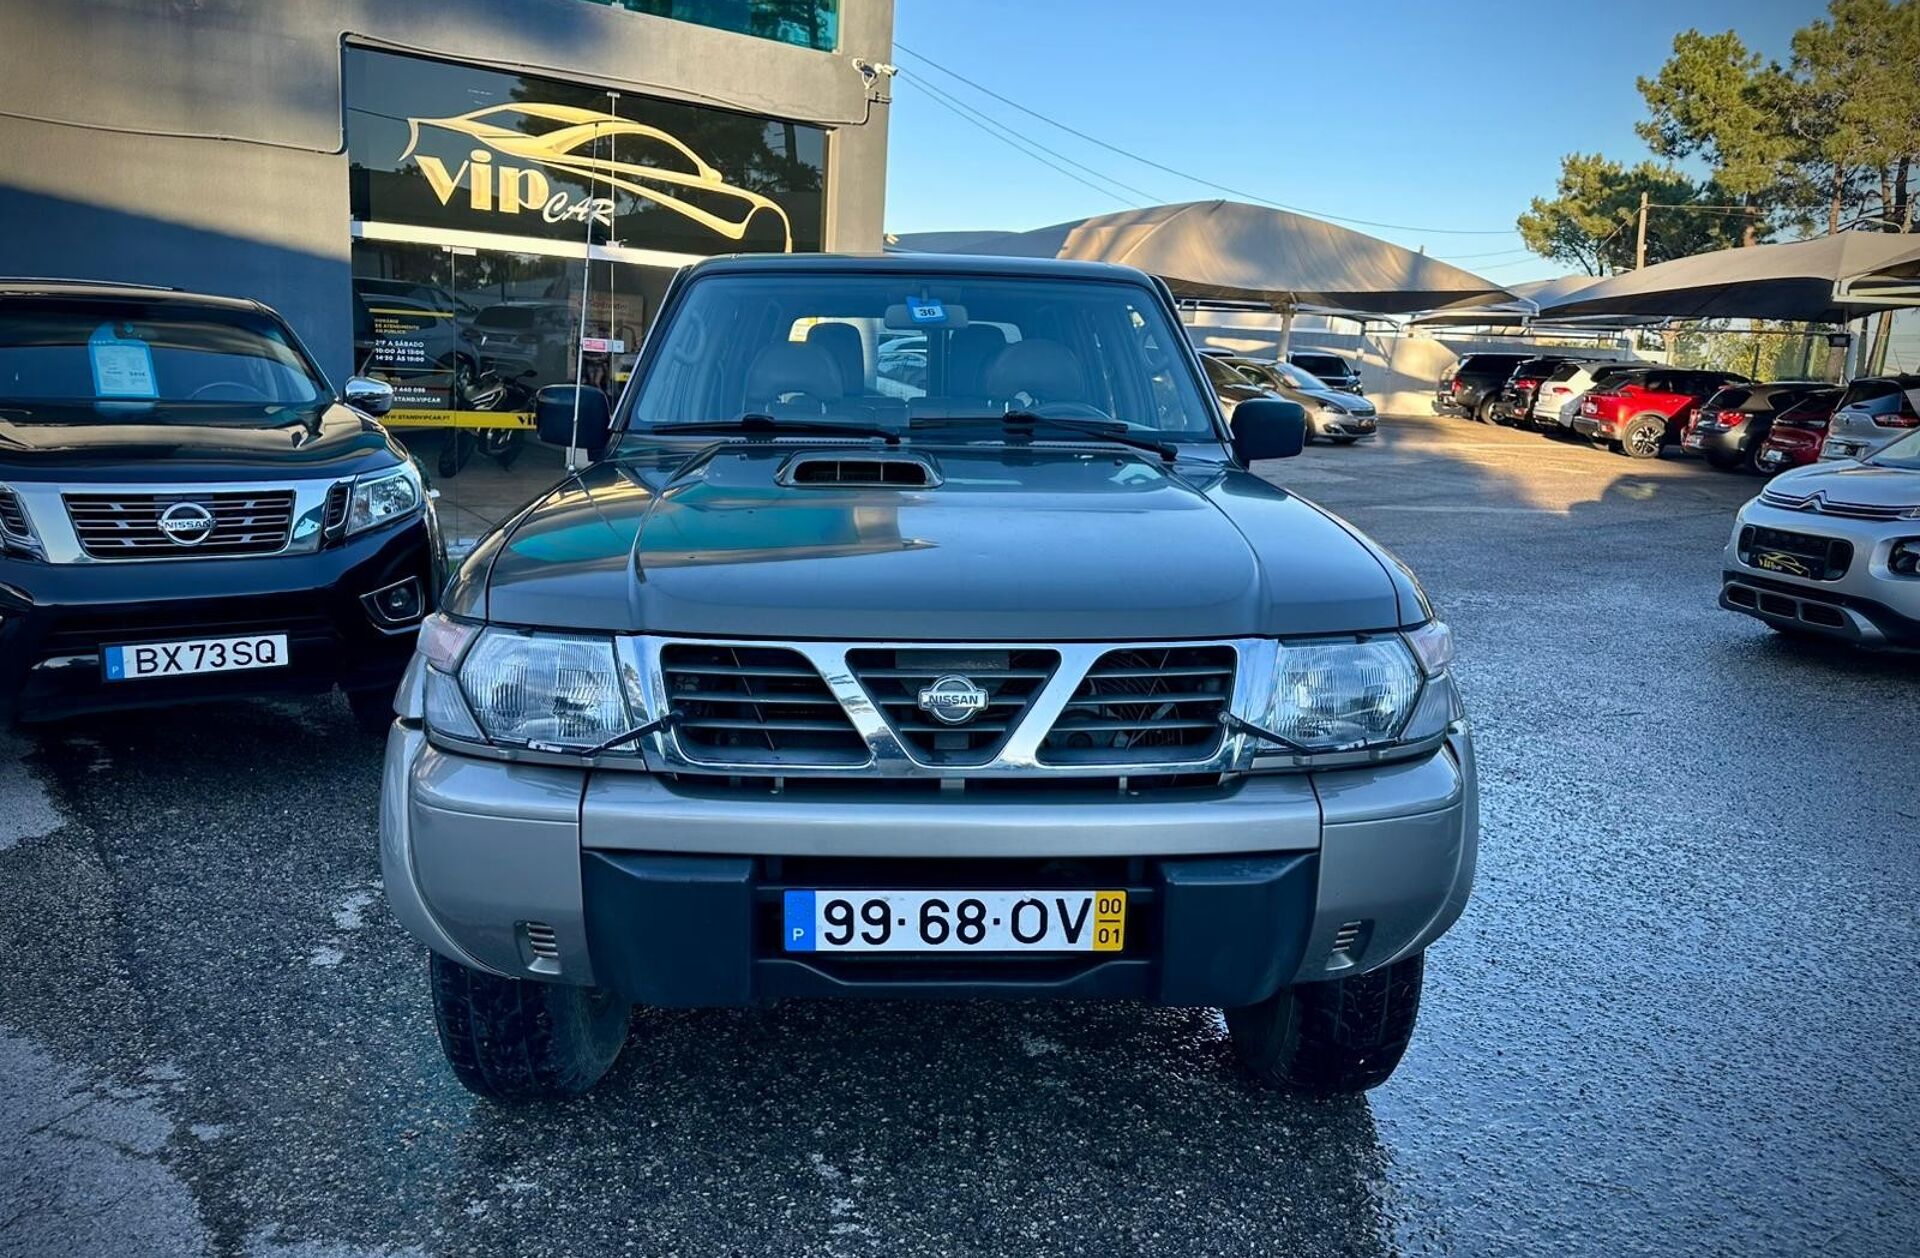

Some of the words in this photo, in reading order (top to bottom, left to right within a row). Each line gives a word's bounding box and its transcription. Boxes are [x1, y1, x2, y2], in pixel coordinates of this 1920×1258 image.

[413, 149, 549, 214] vip
[543, 191, 615, 227] CAR
[918, 308, 936, 317] 36
[394, 339, 425, 348] SÁBADO
[164, 520, 211, 529] NISSAN
[928, 694, 978, 705] NISSAN
[1099, 898, 1122, 914] 00
[792, 928, 804, 941] P
[1098, 927, 1121, 944] 01
